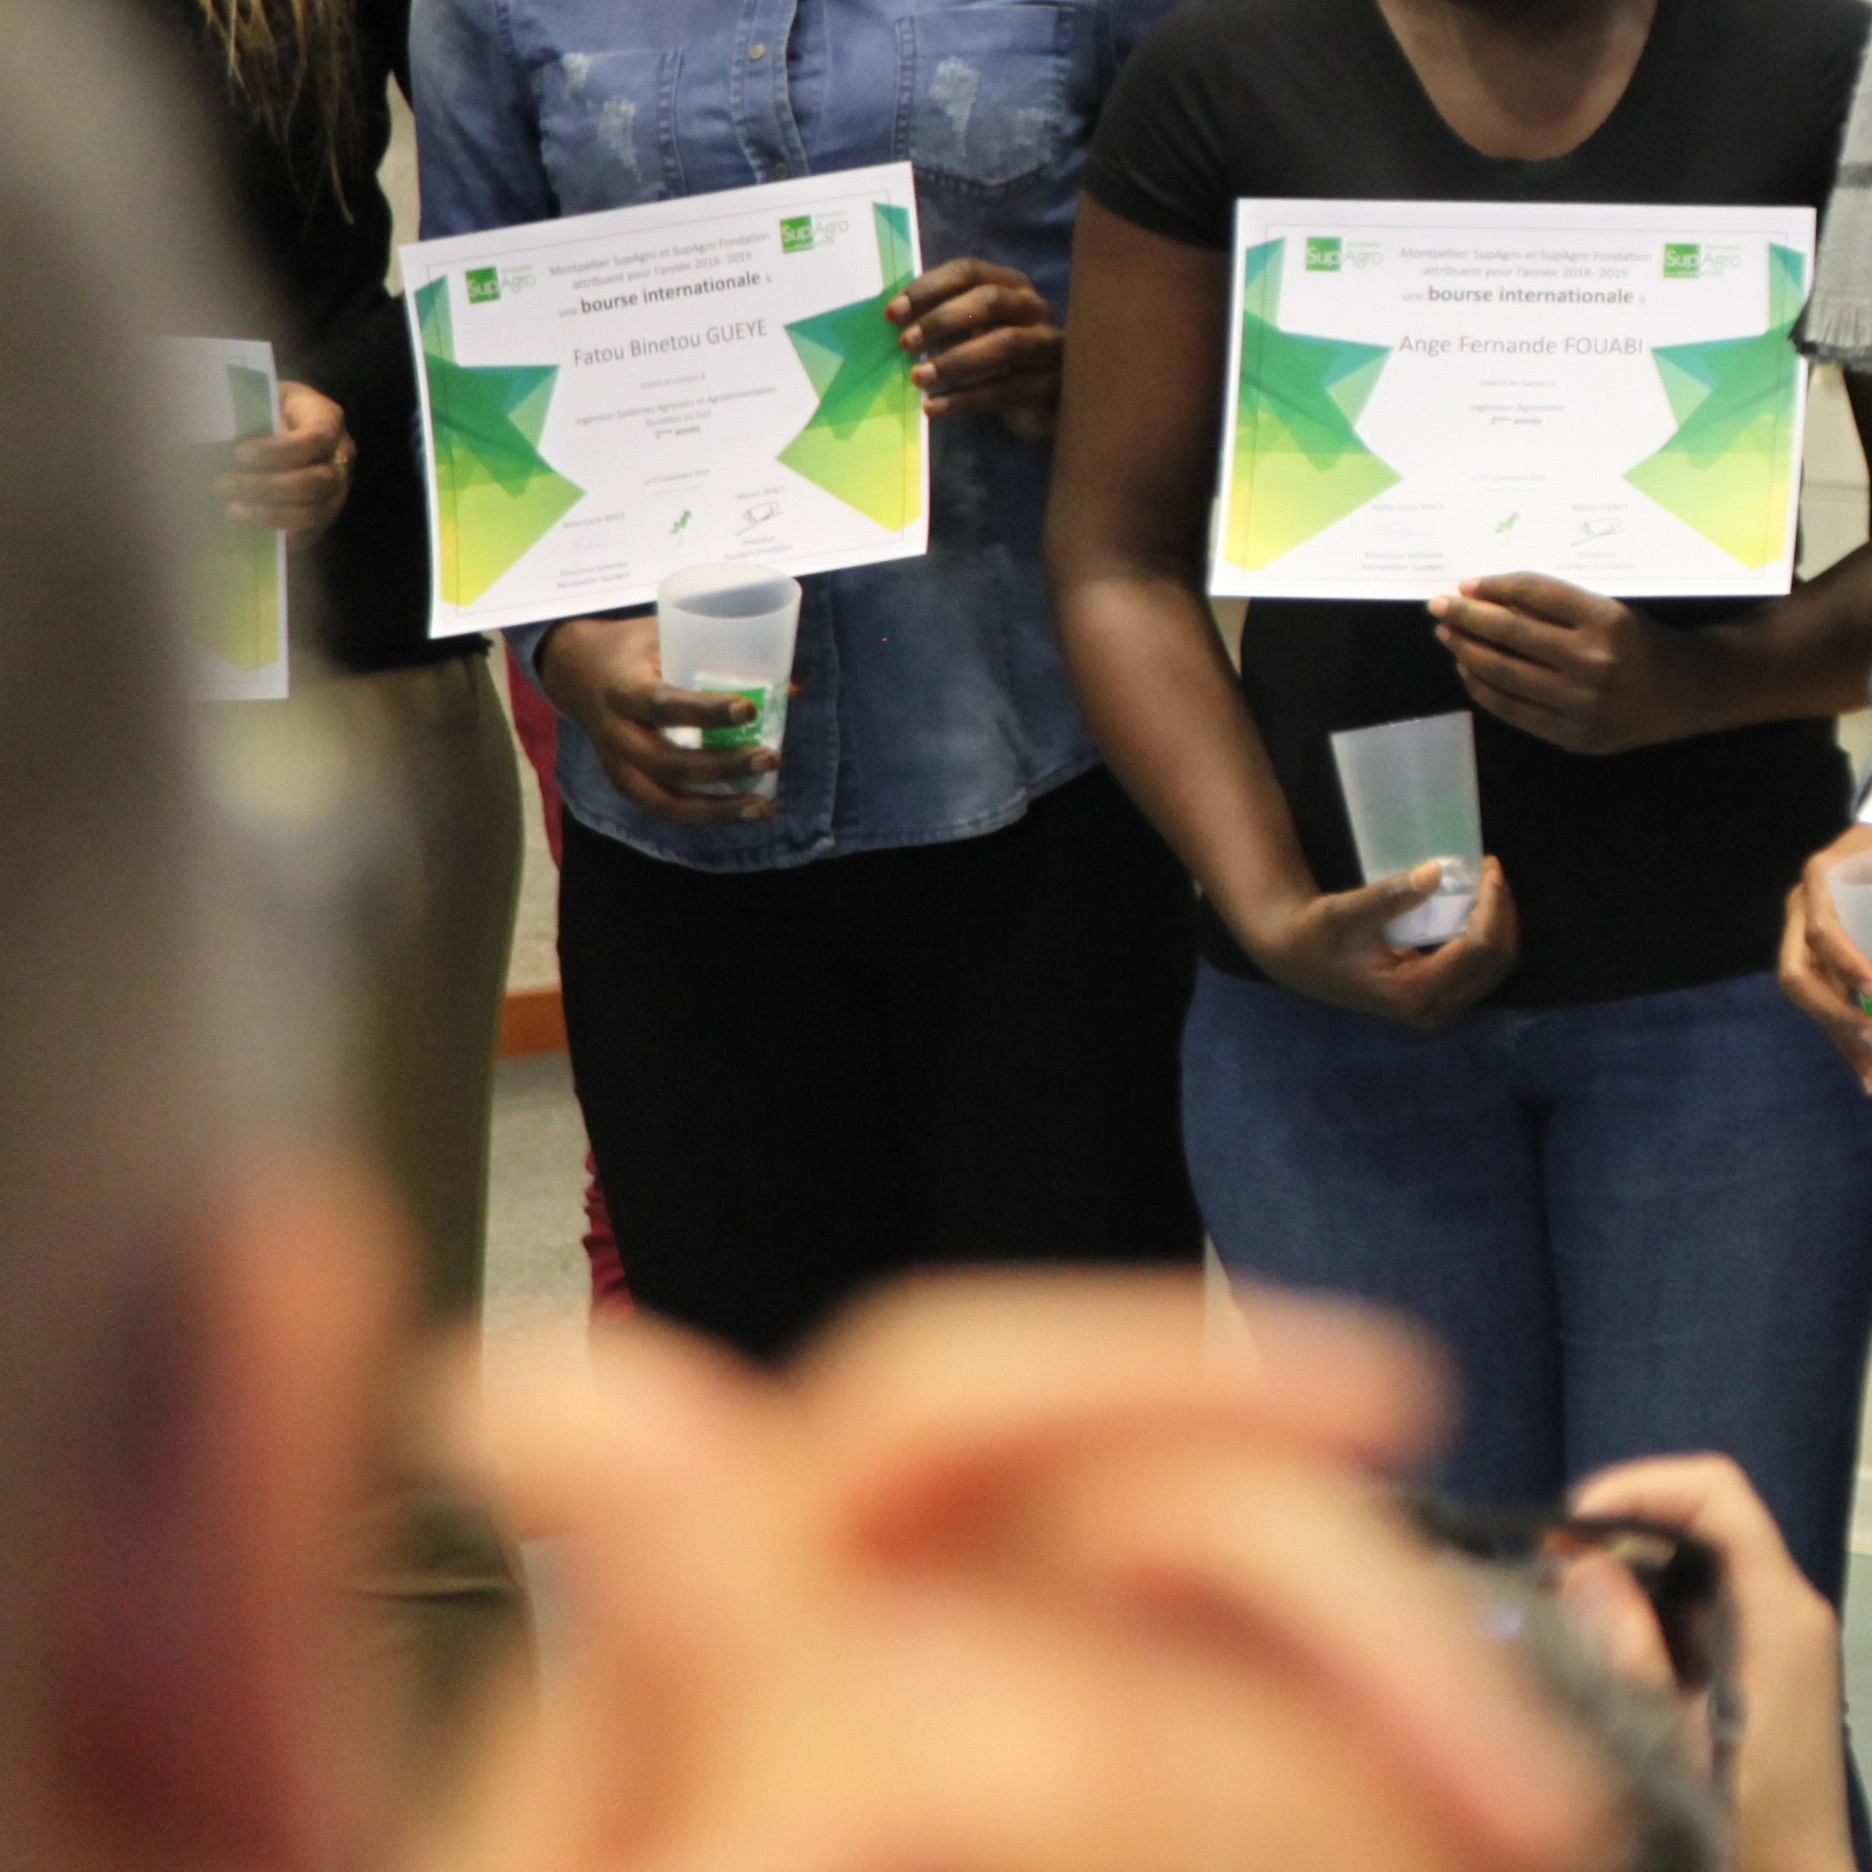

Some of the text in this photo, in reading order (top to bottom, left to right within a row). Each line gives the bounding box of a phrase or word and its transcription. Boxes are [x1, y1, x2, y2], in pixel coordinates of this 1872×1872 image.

[580, 295, 638, 315] bourse
[642, 270, 761, 305] internationale
[1428, 285, 1493, 303] bourse
[1498, 285, 1634, 305] internationale
[573, 317, 768, 367] Fatou Binetou GUEYE
[1399, 335, 1643, 358] Ange Fernande FOUABI
